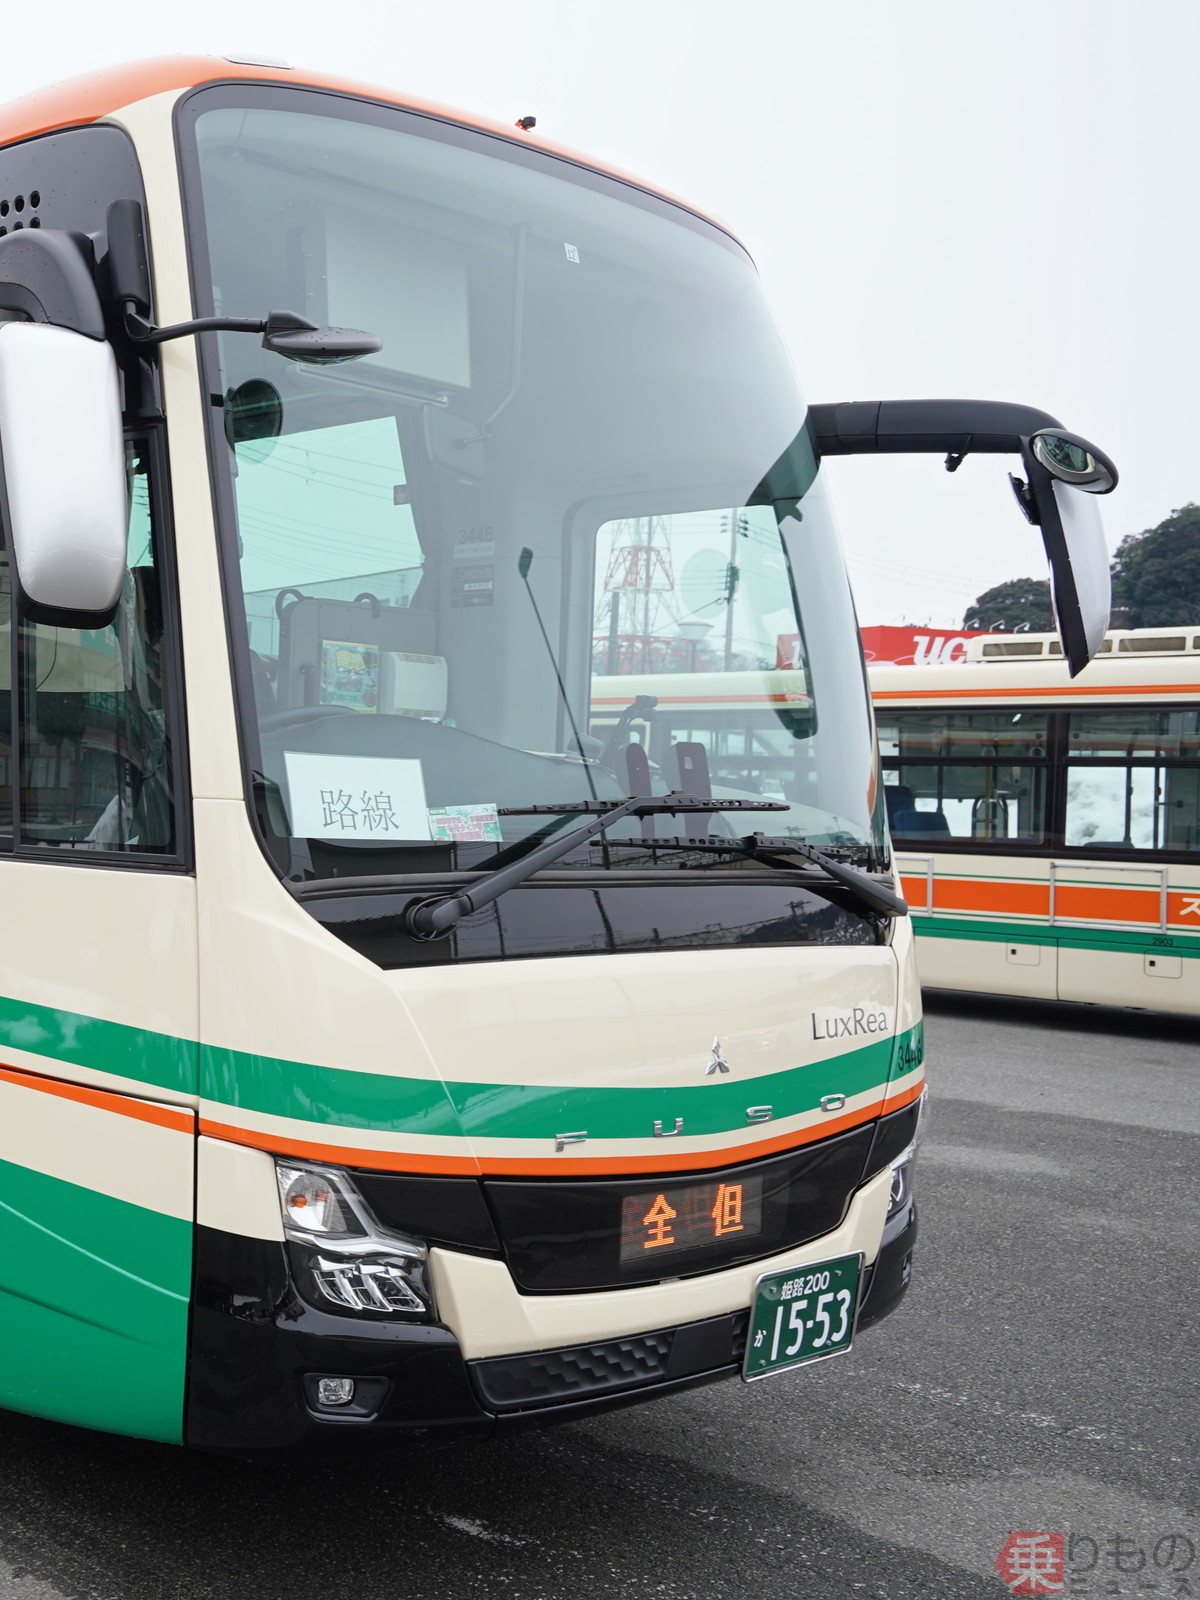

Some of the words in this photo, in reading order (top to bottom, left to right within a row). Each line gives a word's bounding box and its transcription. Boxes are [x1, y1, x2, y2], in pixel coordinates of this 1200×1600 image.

[458, 526, 494, 544] 3446
[319, 788, 400, 833] 路線
[1152, 937, 1174, 946] 2903
[811, 1006, 888, 1041] LuxRea
[555, 1094, 846, 1153] FUSO
[642, 1183, 745, 1249] 全但
[753, 1329, 767, 1347] か
[770, 1289, 851, 1361] 15-53
